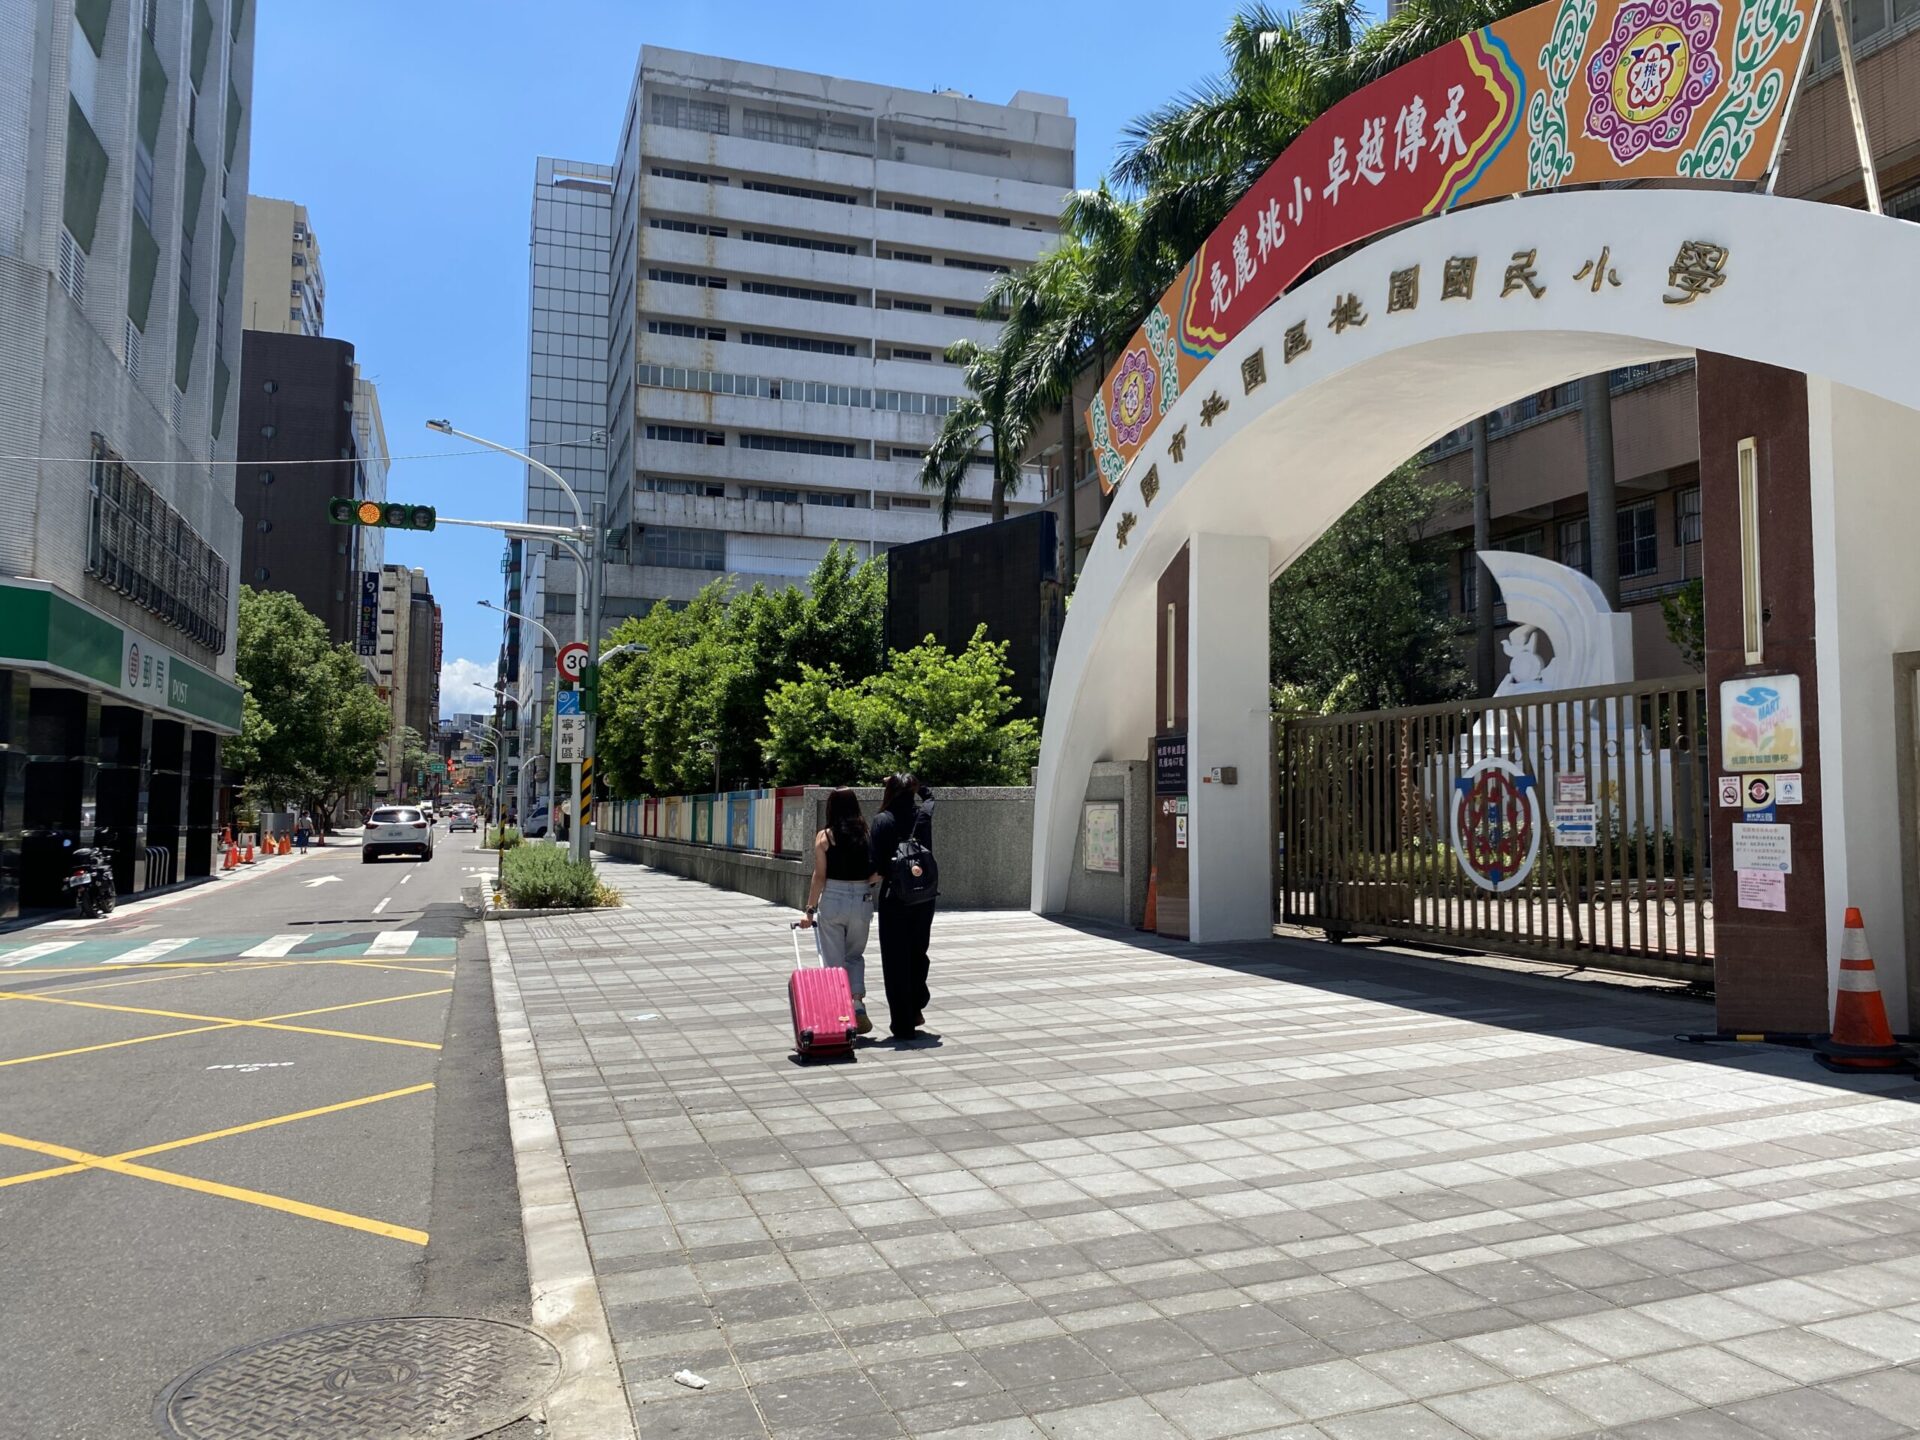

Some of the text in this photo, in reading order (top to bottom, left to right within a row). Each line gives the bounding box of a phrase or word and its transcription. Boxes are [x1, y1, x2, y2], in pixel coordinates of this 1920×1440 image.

[1641, 62, 1658, 91] 桃小
[143, 654, 164, 694] 郵局
[566, 655, 588, 670] 30
[172, 679, 188, 704] POST
[561, 718, 574, 759] 寧靜區
